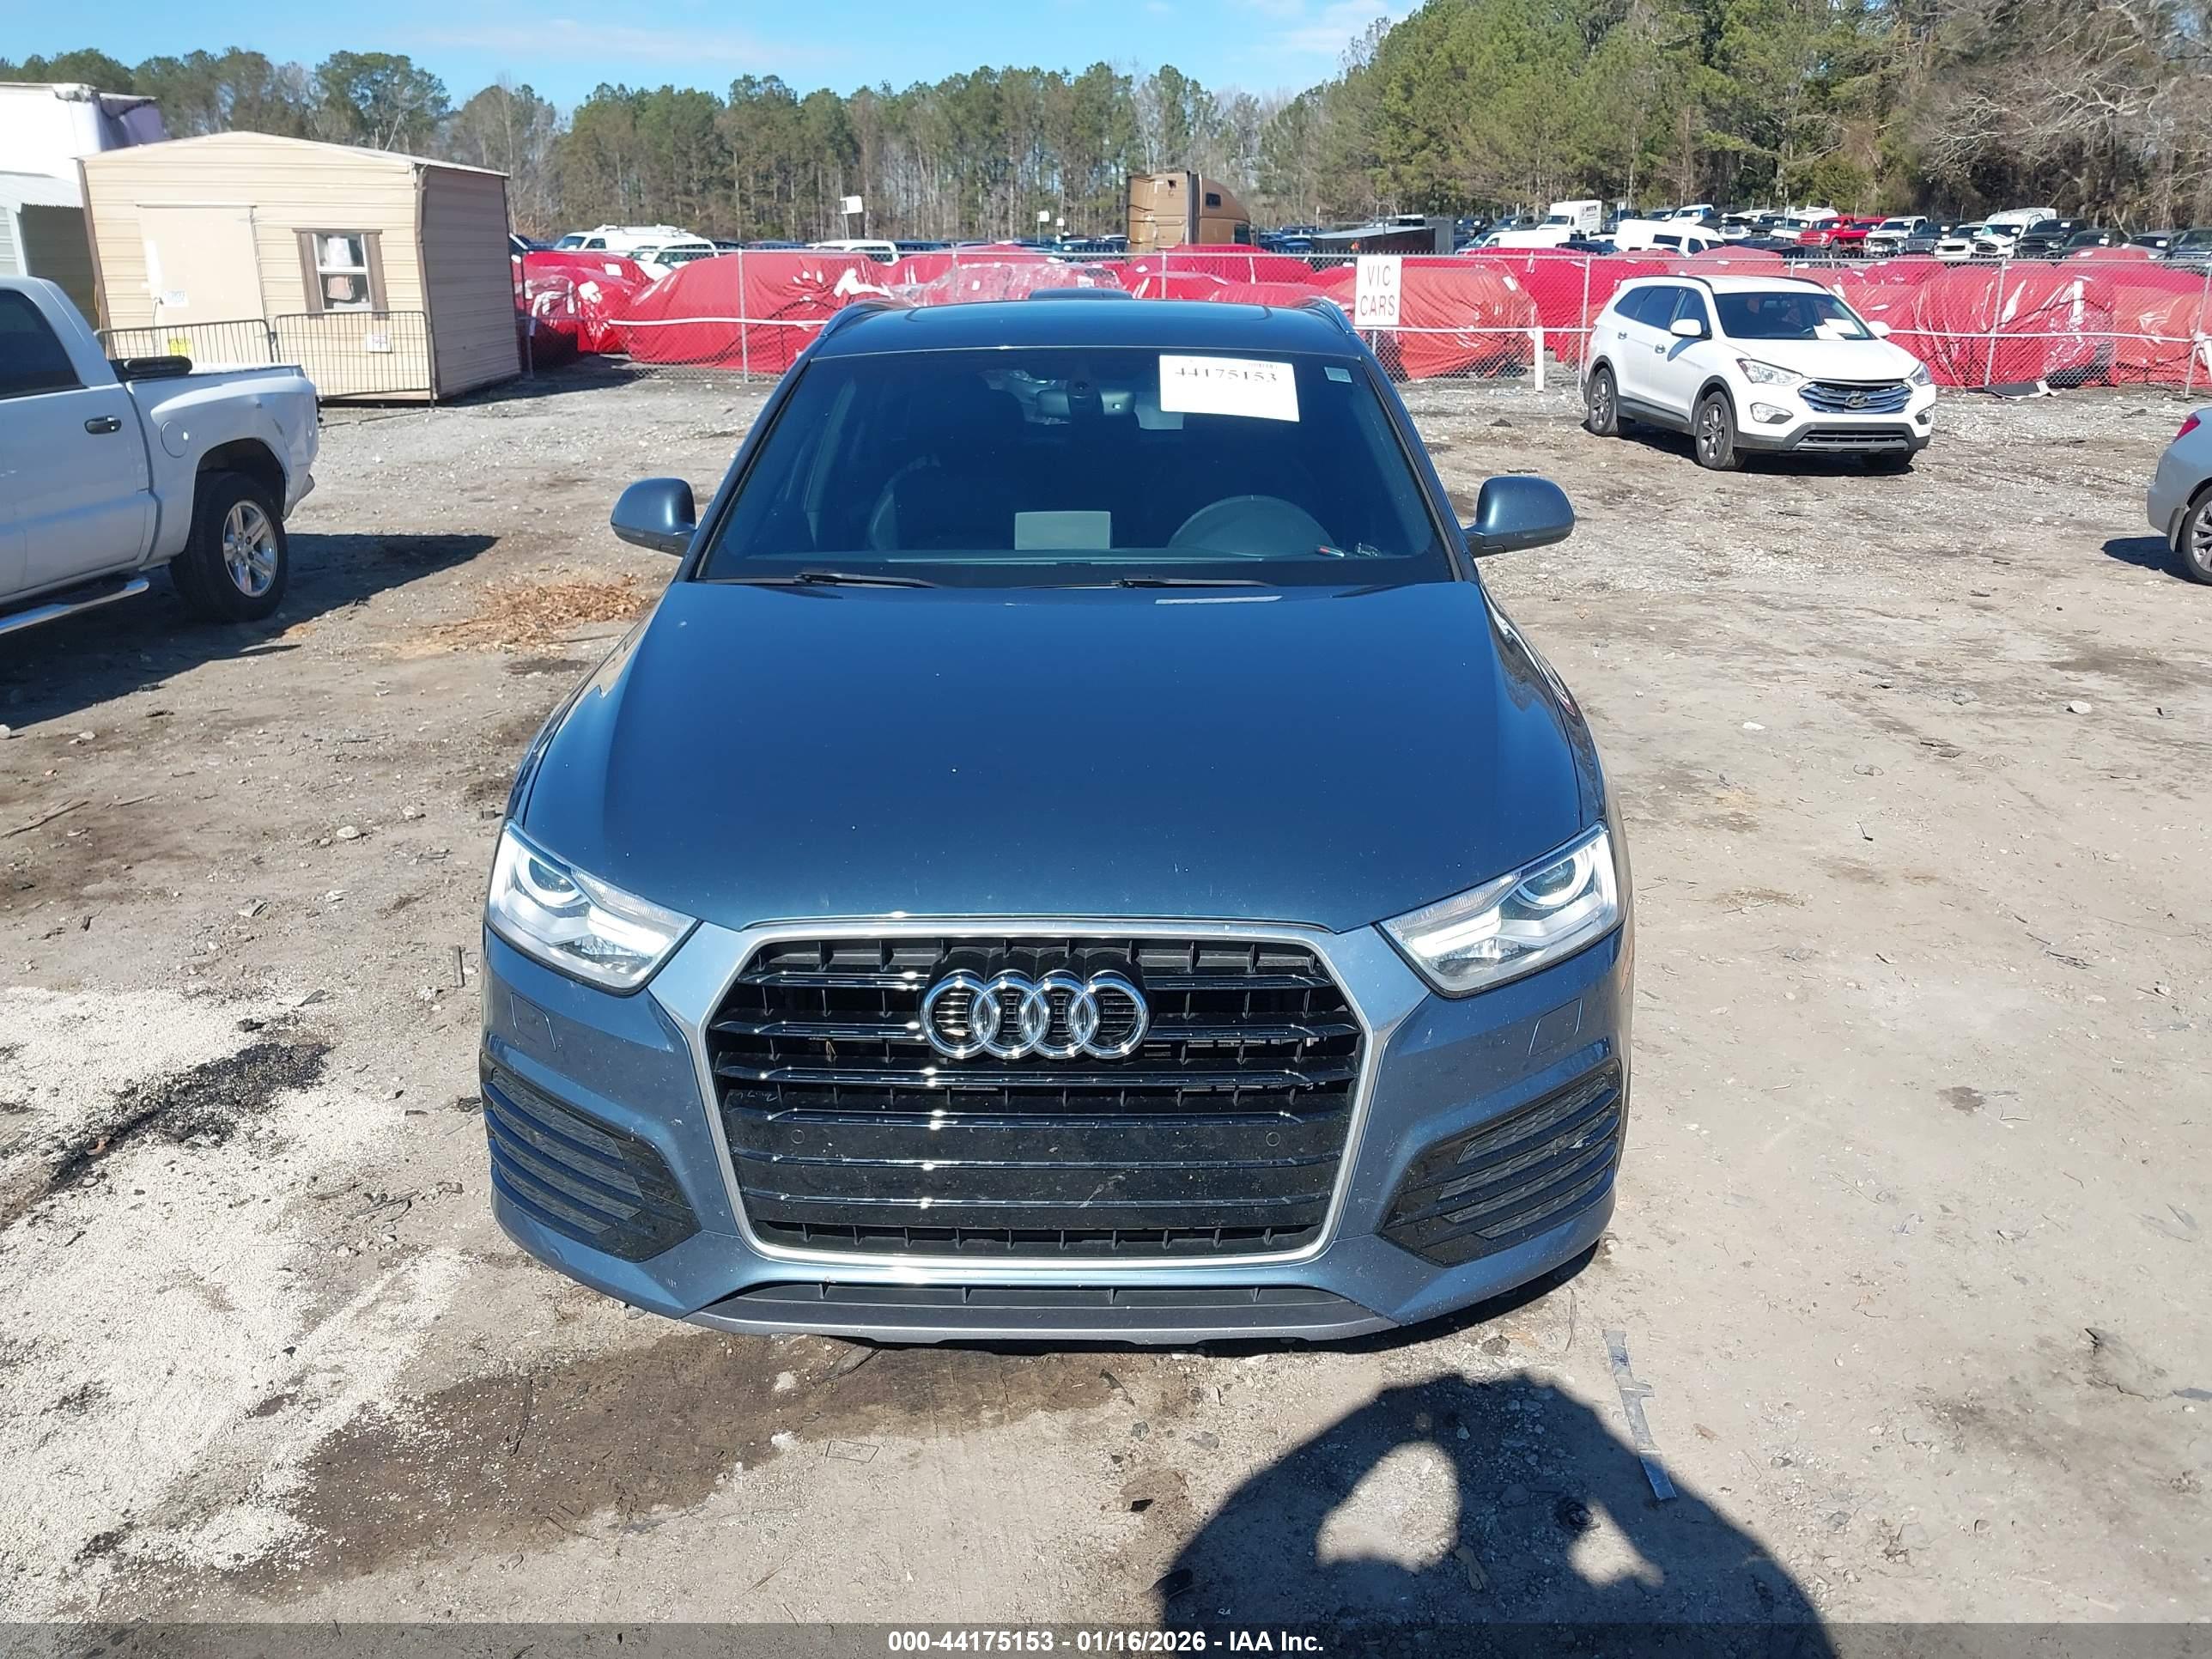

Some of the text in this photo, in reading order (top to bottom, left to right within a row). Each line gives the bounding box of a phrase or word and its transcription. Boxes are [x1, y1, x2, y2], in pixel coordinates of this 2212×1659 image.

[1367, 264, 1391, 287] VIC
[1360, 295, 1395, 317] CARS
[1175, 367, 1278, 383] 44175153
